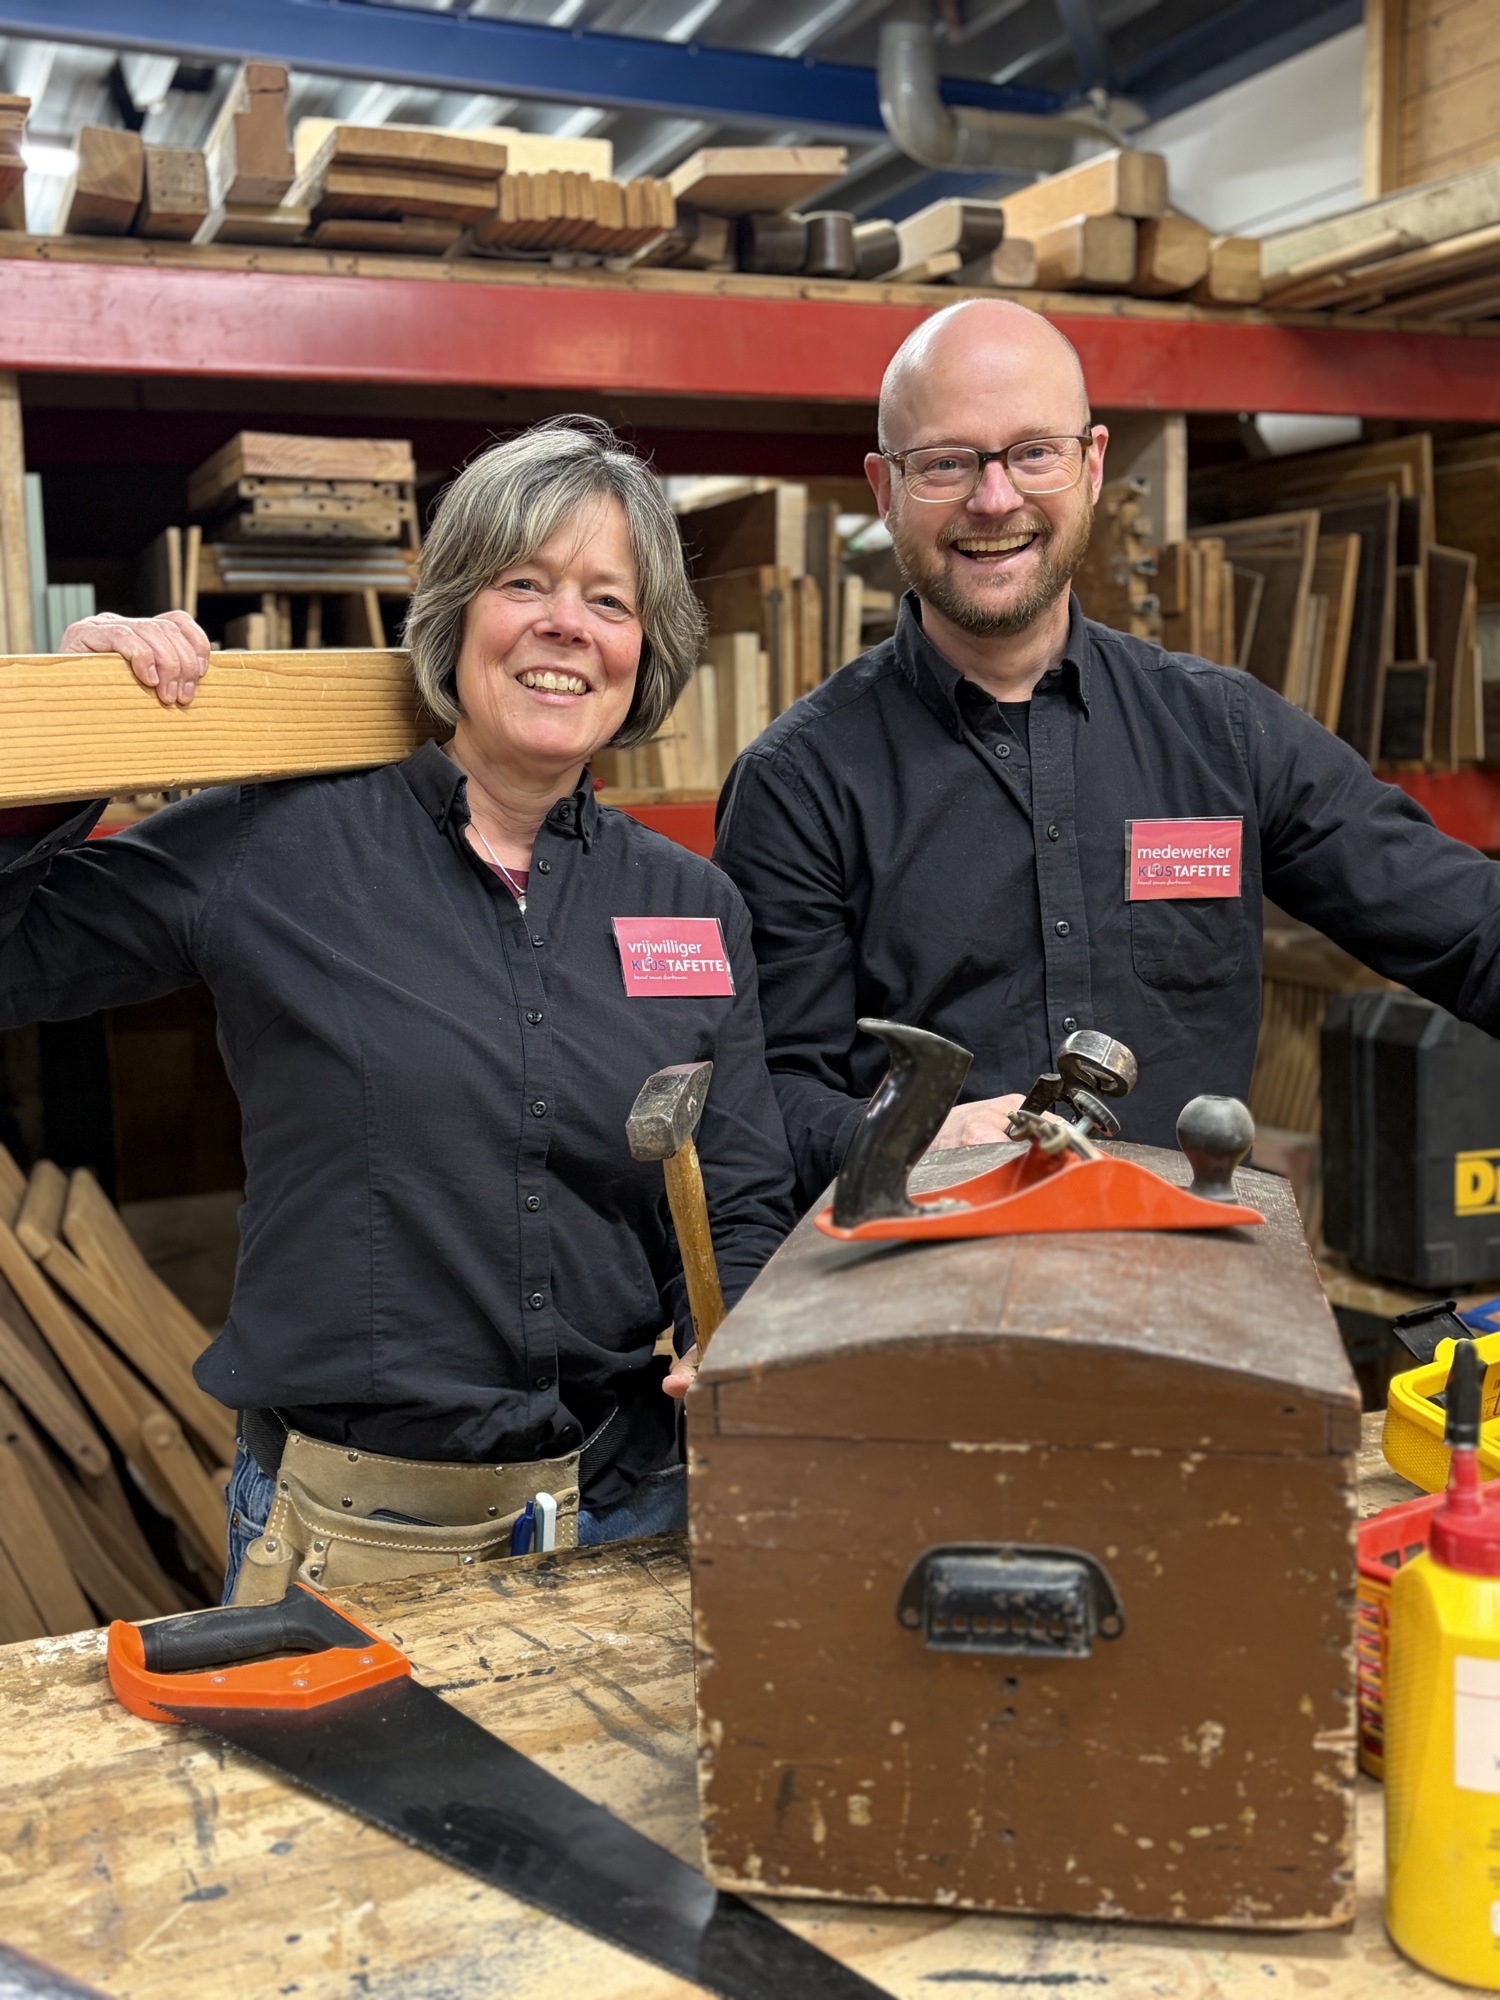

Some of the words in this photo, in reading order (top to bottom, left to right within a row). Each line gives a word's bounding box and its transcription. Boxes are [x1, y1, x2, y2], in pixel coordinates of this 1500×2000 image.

[1137, 844, 1231, 859] medewerker
[627, 940, 702, 957] vrijwilliger
[1455, 1158, 1500, 1208] D
